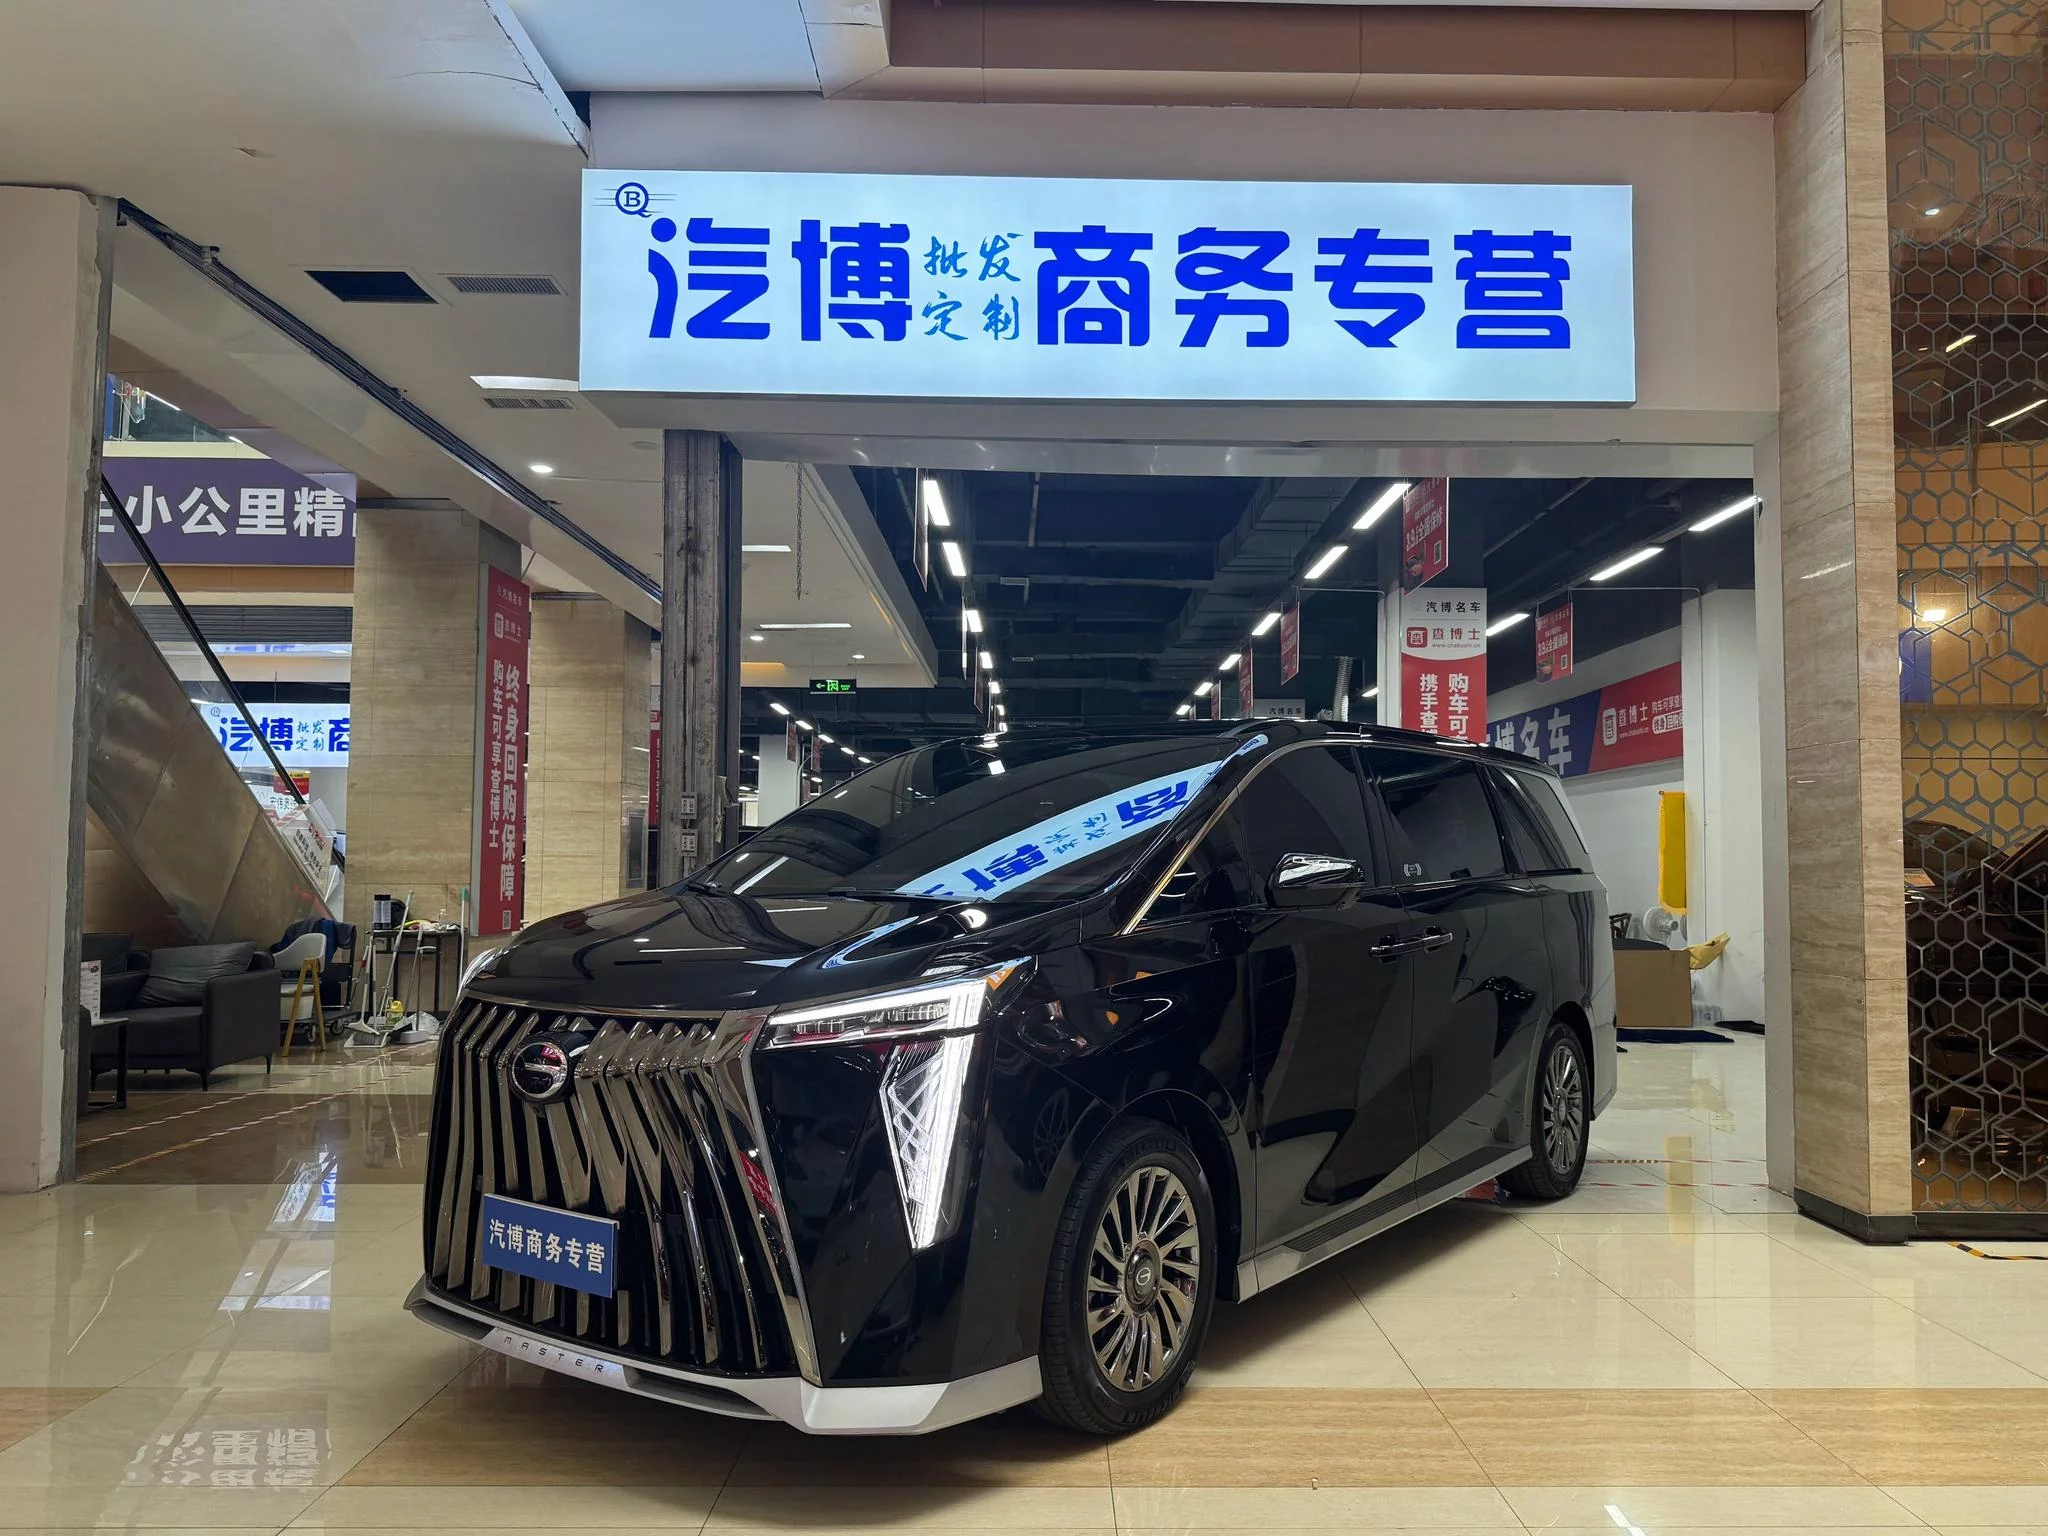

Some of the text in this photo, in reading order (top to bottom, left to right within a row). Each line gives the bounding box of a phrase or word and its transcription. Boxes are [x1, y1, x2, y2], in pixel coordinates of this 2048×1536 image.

[649, 217, 1571, 348] 汽博 商务专营
[98, 486, 356, 538] 小公里精
[1426, 601, 1481, 613] 汽博名车
[1432, 627, 1480, 640] 查博士
[1619, 702, 1648, 727] 查博士
[1652, 694, 1683, 714] 购车可享查
[219, 717, 293, 752] 汽博
[489, 660, 504, 848] 购车可享查博士
[1485, 707, 1572, 776] 博名车
[500, 664, 520, 901] 终身回购保障
[489, 1218, 605, 1274] 汽博商务专营
[504, 1336, 604, 1373] MASTER
